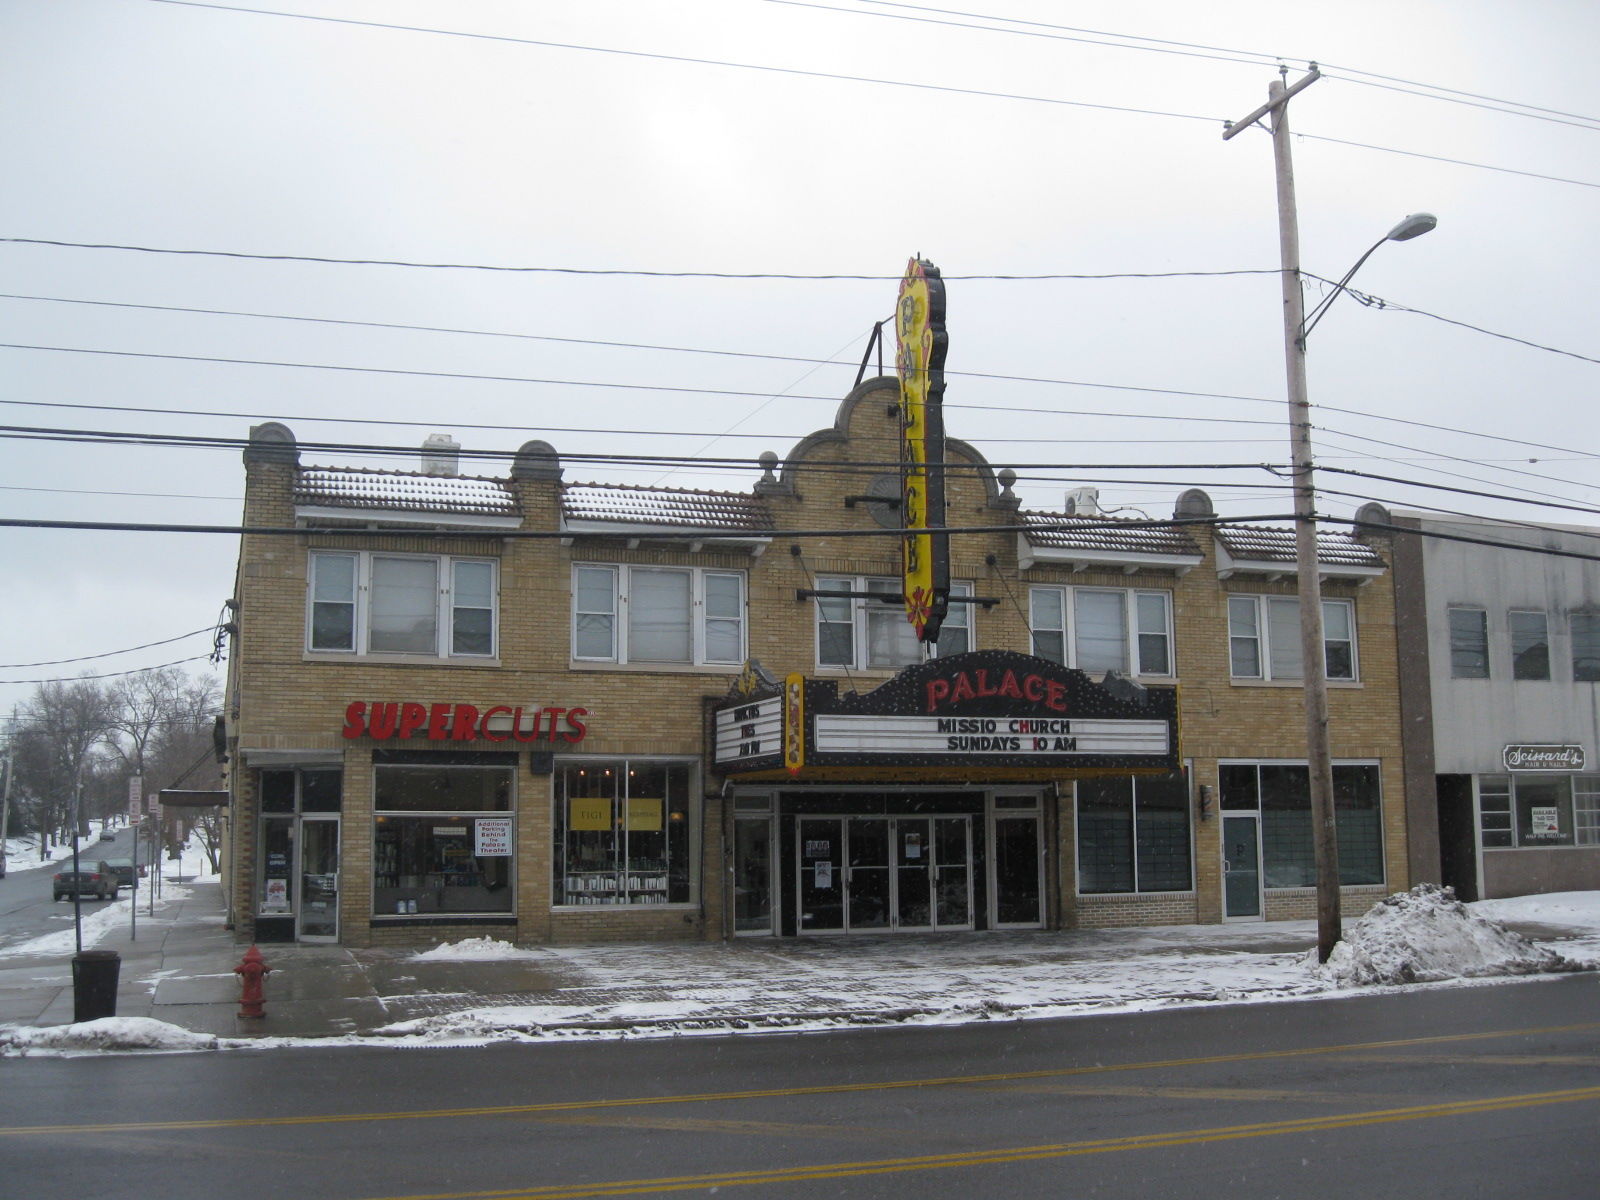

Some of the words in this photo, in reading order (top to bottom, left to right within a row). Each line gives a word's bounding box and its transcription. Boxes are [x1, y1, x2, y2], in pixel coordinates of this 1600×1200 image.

[926, 668, 1067, 713] PALACE
[342, 701, 588, 744] SUPERCUTS
[938, 718, 996, 733] MISSIO
[1008, 719, 1071, 734] CHURCH
[948, 735, 1020, 751] SUNDAYS
[1053, 736, 1077, 751] AM
